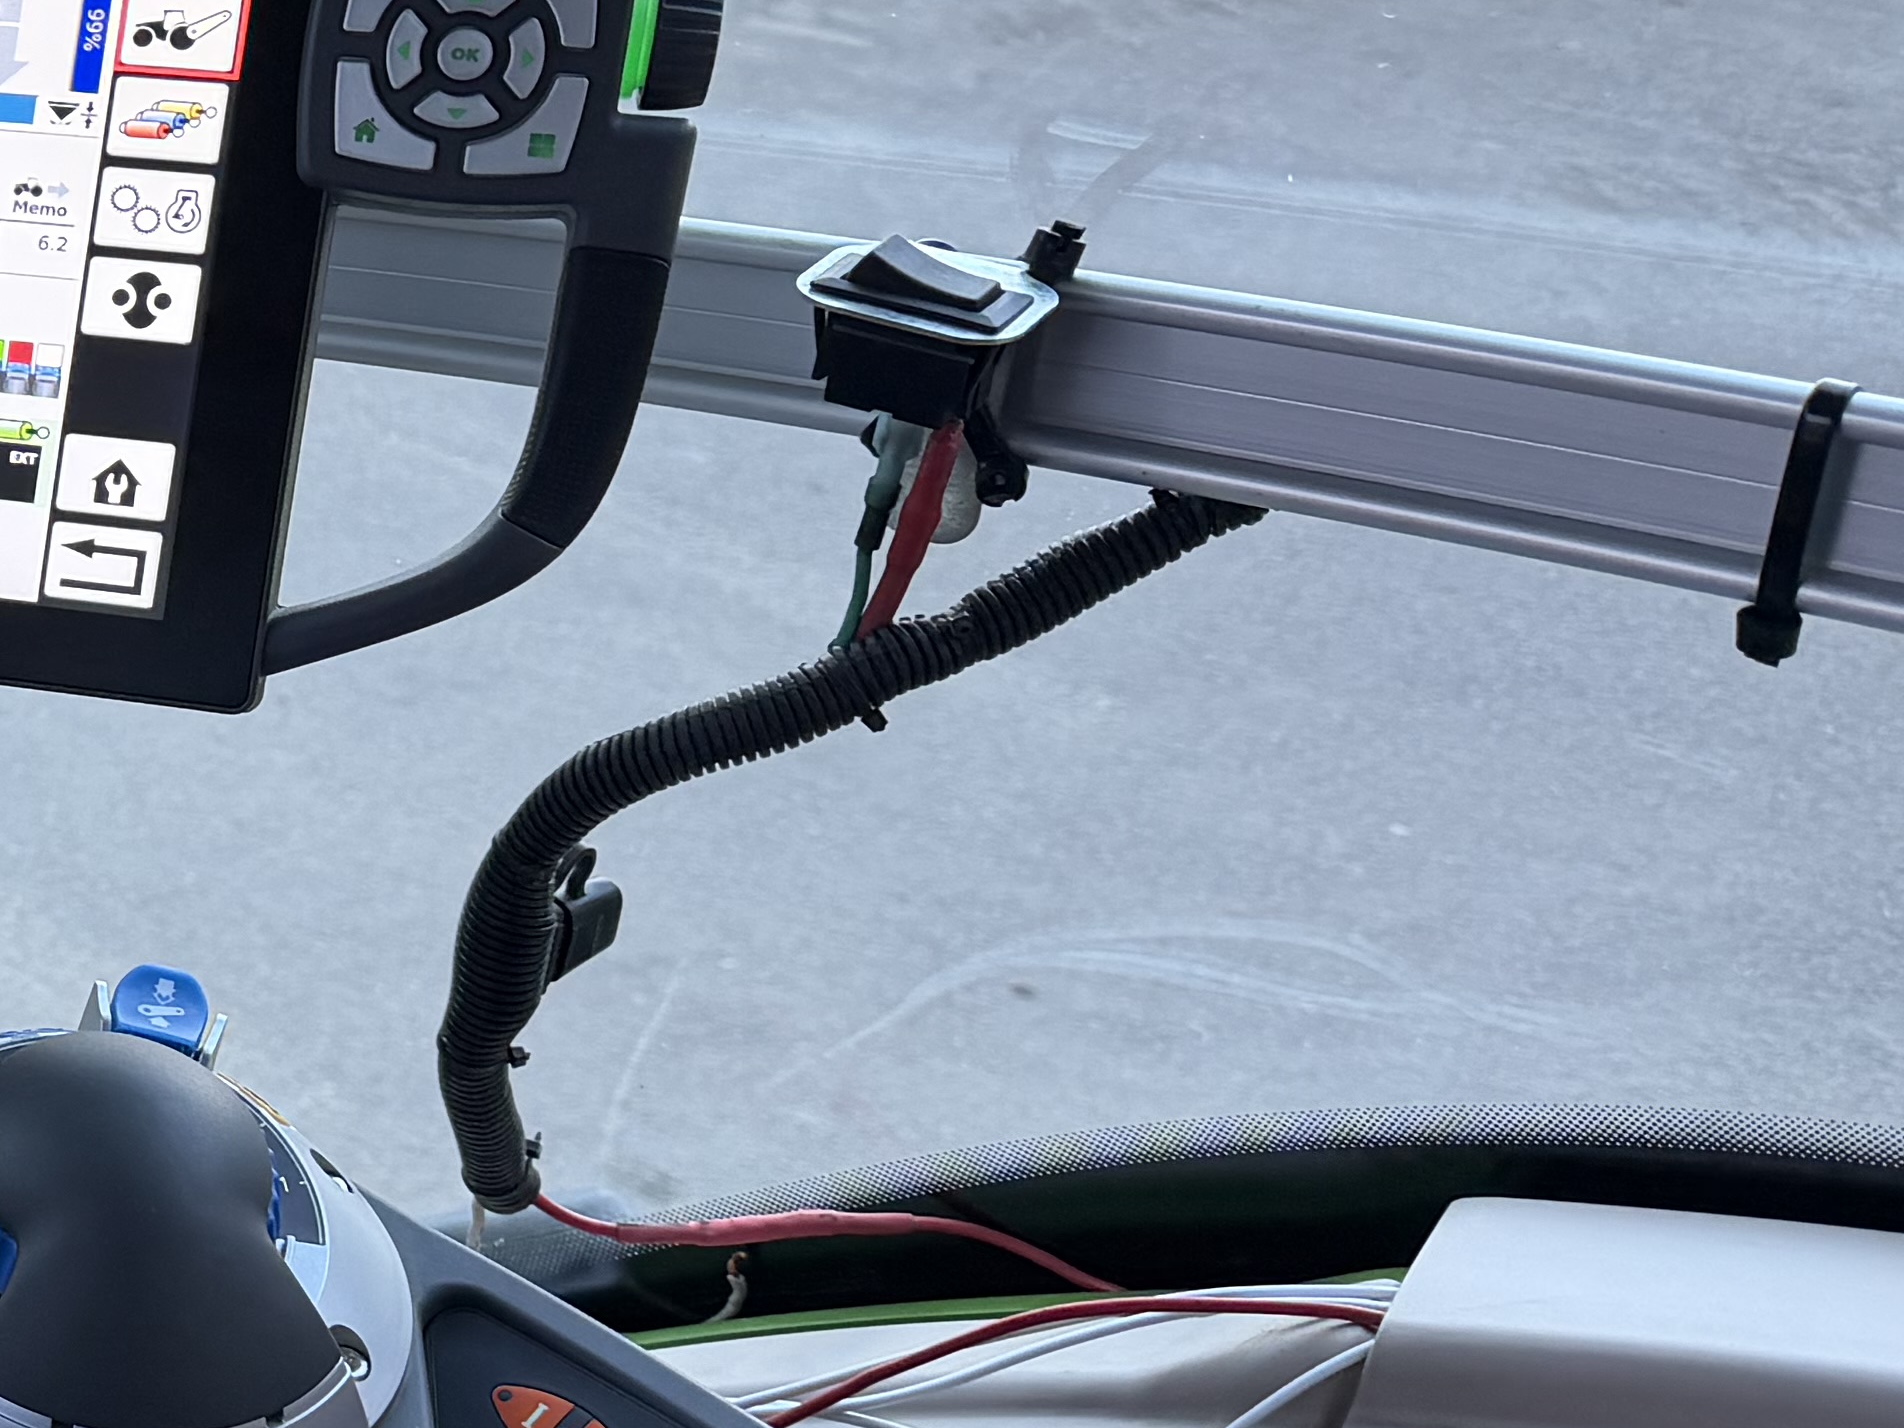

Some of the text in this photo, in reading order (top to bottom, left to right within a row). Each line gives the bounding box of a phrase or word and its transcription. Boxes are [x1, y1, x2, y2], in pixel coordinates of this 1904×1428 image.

[83, 8, 106, 52] 99%
[450, 47, 481, 62] OK
[12, 199, 68, 218] Memo
[38, 235, 68, 252] 6.2
